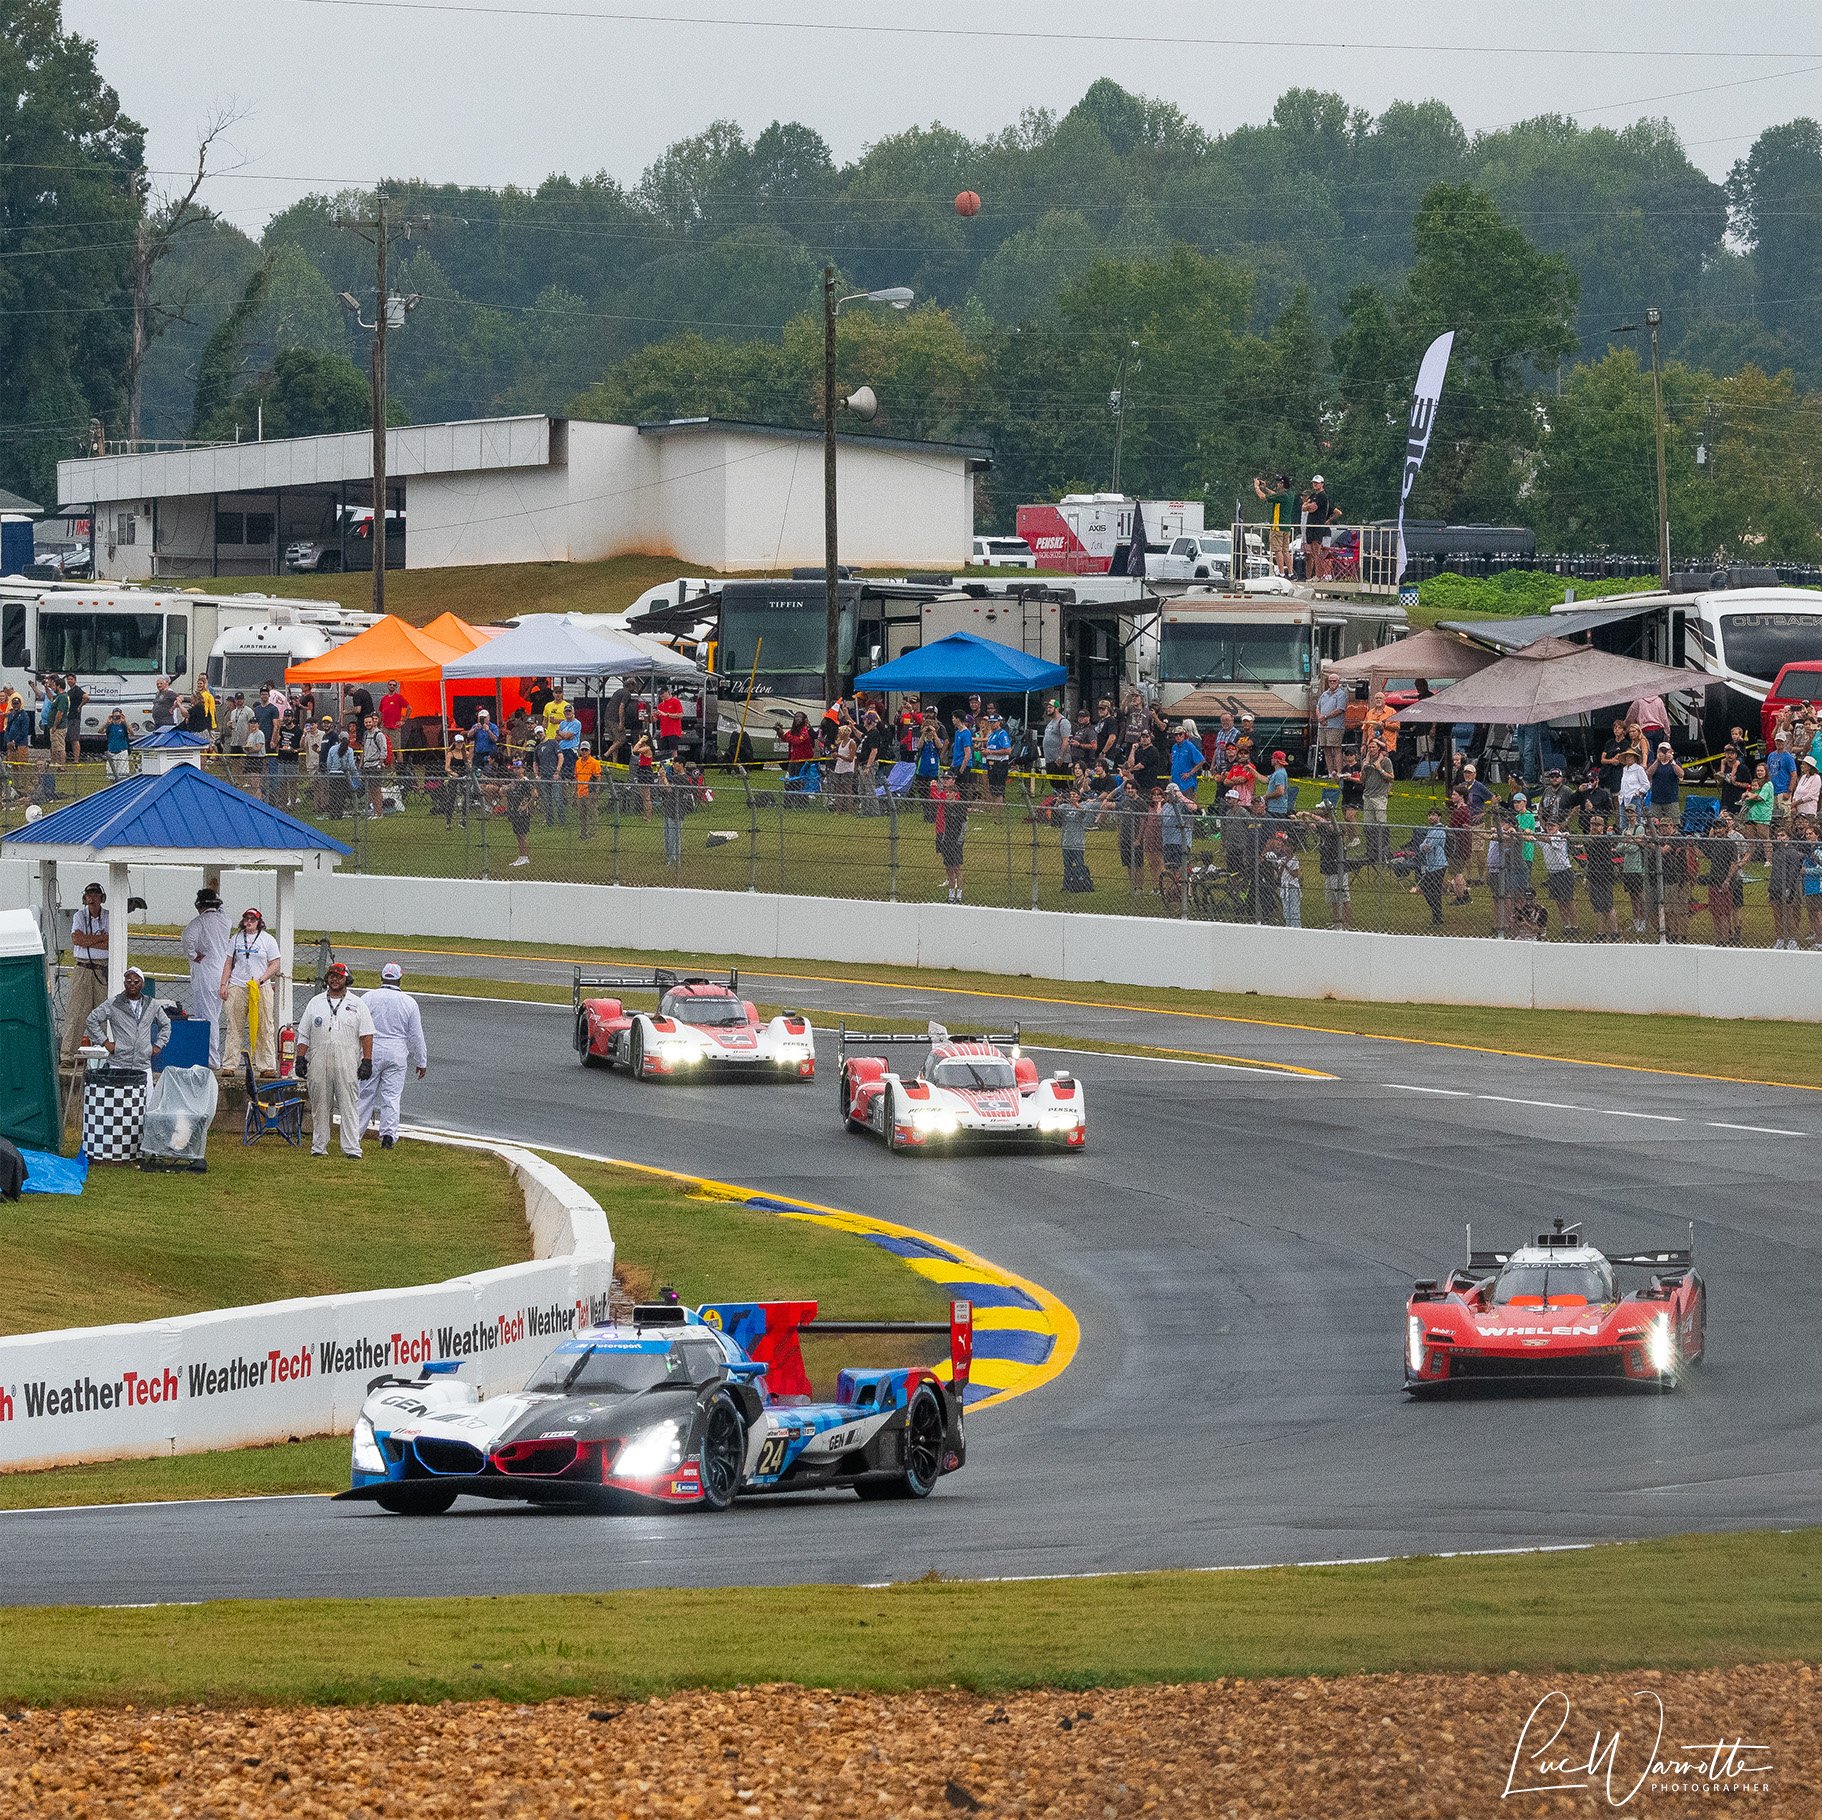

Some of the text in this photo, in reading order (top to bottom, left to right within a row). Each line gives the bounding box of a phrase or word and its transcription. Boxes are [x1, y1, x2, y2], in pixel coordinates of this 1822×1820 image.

[1088, 523, 1107, 532] AXIS
[1035, 536, 1065, 550] PENSKE
[90, 685, 119, 694] Horizon
[314, 852, 321, 870] 1
[1476, 1325, 1599, 1337] WHELEN
[380, 1395, 429, 1418] GEN
[829, 1433, 845, 1451] GEN
[758, 1440, 785, 1476] 24
